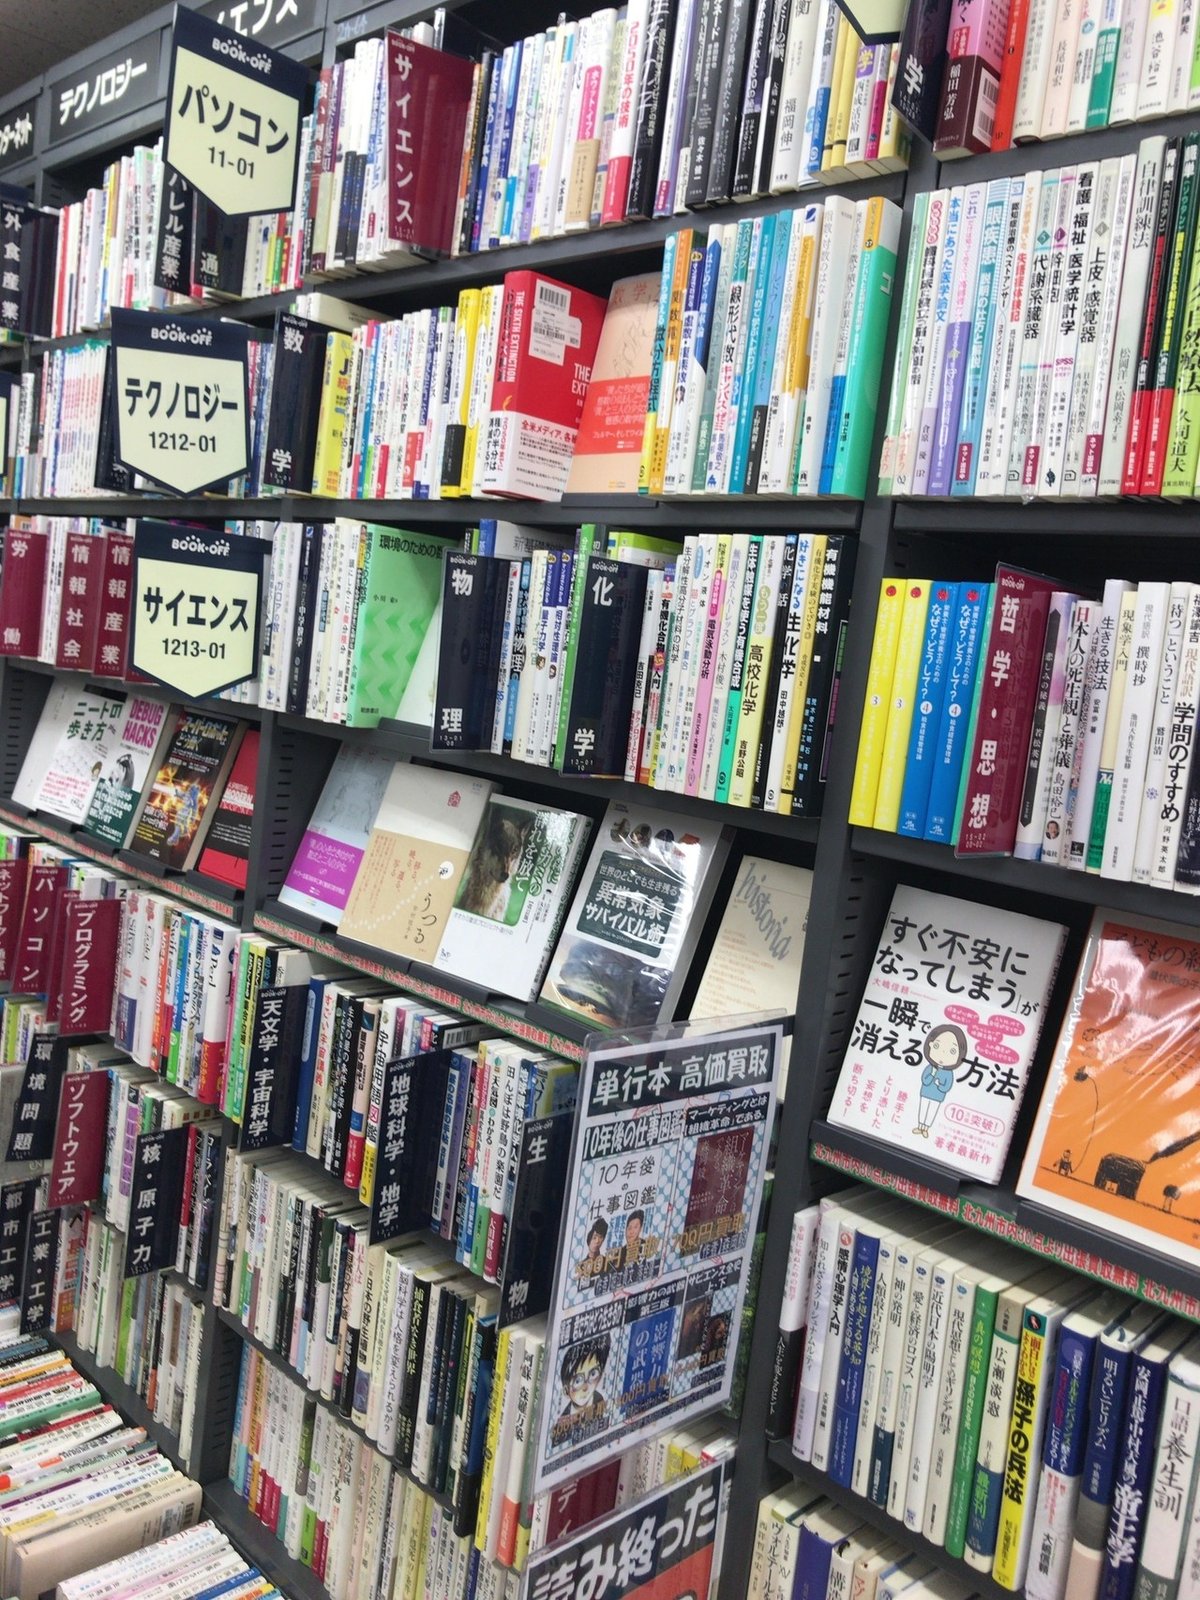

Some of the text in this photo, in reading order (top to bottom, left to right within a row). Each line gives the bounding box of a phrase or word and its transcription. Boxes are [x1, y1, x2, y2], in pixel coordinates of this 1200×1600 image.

[58, 57, 148, 126] テクノロジー
[903, 53, 925, 95] 学
[178, 84, 289, 155] パソコン
[394, 53, 414, 225] サイエンス
[780, 97, 798, 153] 福岡伸一
[208, 146, 256, 179] 11-01
[981, 204, 1001, 264] 眼疾患
[1131, 160, 1159, 251] 自律訓練法
[2, 212, 21, 320] 外食産業
[934, 196, 962, 323] 本当にあった医学論文
[1059, 171, 1096, 337] 看護・福祉・医学統計学
[513, 306, 524, 331] SIXTH
[722, 283, 743, 364] 線形代数
[1024, 253, 1048, 341] 代謝系臓器
[1080, 246, 1106, 344] 上皮・感覚器
[506, 333, 521, 382] EXTINCTION
[125, 377, 238, 423] テクノロジー
[149, 432, 217, 453] 1212-01
[1170, 410, 1192, 474] 久司道夫
[64, 545, 90, 657] 情報社会
[102, 546, 131, 665] 情報産業
[792, 539, 808, 610] 好きになる
[143, 586, 249, 633] サイエンス
[1115, 608, 1136, 672] 現象学入門
[162, 638, 226, 660] 1213-01
[781, 611, 801, 679] 生化学
[1093, 615, 1116, 691] 生きる技法
[1132, 645, 1151, 687] 撰時抄
[1160, 596, 1186, 706] 「待つ」ということ
[74, 701, 123, 719] ニートの
[130, 699, 164, 726] DEBUG
[741, 645, 764, 716] 高校化学
[968, 594, 1021, 830] 哲学・思想
[1054, 605, 1091, 769] 日本人の死生観と葬儀
[65, 721, 108, 742] 歩き方
[122, 722, 158, 749] HACKS
[1160, 702, 1197, 824] 学問のすすめ
[1156, 825, 1173, 875] 河野英太郎
[22, 877, 54, 983] パソコン
[168, 918, 180, 956] Swift
[69, 910, 96, 1024] プログラミング
[850, 1019, 924, 1067] 消える
[863, 997, 932, 1035] 一瞬で
[13, 1042, 53, 1151] 環境問題
[248, 999, 283, 1137] 天文学・宇宙科学
[592, 1043, 770, 1107] 単行本 高価買取
[956, 1056, 1020, 1101] 方法
[57, 1082, 86, 1196] ソフトウェア
[582, 1109, 687, 1159] 10年後の仕事図鑑
[688, 1095, 769, 1119] マーケティングとは
[890, 1090, 909, 1125] 勝手に
[378, 1075, 410, 1227] 地球科学・地学
[598, 1155, 657, 1187] 10年後
[934, 1136, 994, 1167] 著者最新作
[132, 1144, 161, 1264] 核・原子力
[588, 1186, 658, 1221] 仕事図鑑
[621, 1182, 630, 1191] の
[26, 1219, 52, 1323] 工業・工学
[962, 1202, 1140, 1292] 北九州市内30点より出張買取無料
[828, 1246, 852, 1337] 感情心理学・入門
[888, 1276, 906, 1329] 神の発明
[904, 1289, 924, 1379] 愛と経済のロゴス
[921, 1286, 945, 1390] 近代日本の陽明学
[1094, 1357, 1117, 1451] 明るいニヒリズム
[1004, 1378, 1035, 1506] 孫子の兵法
[1152, 1397, 1193, 1521] 口語養生訓
[972, 1470, 991, 1520] 最新刊
